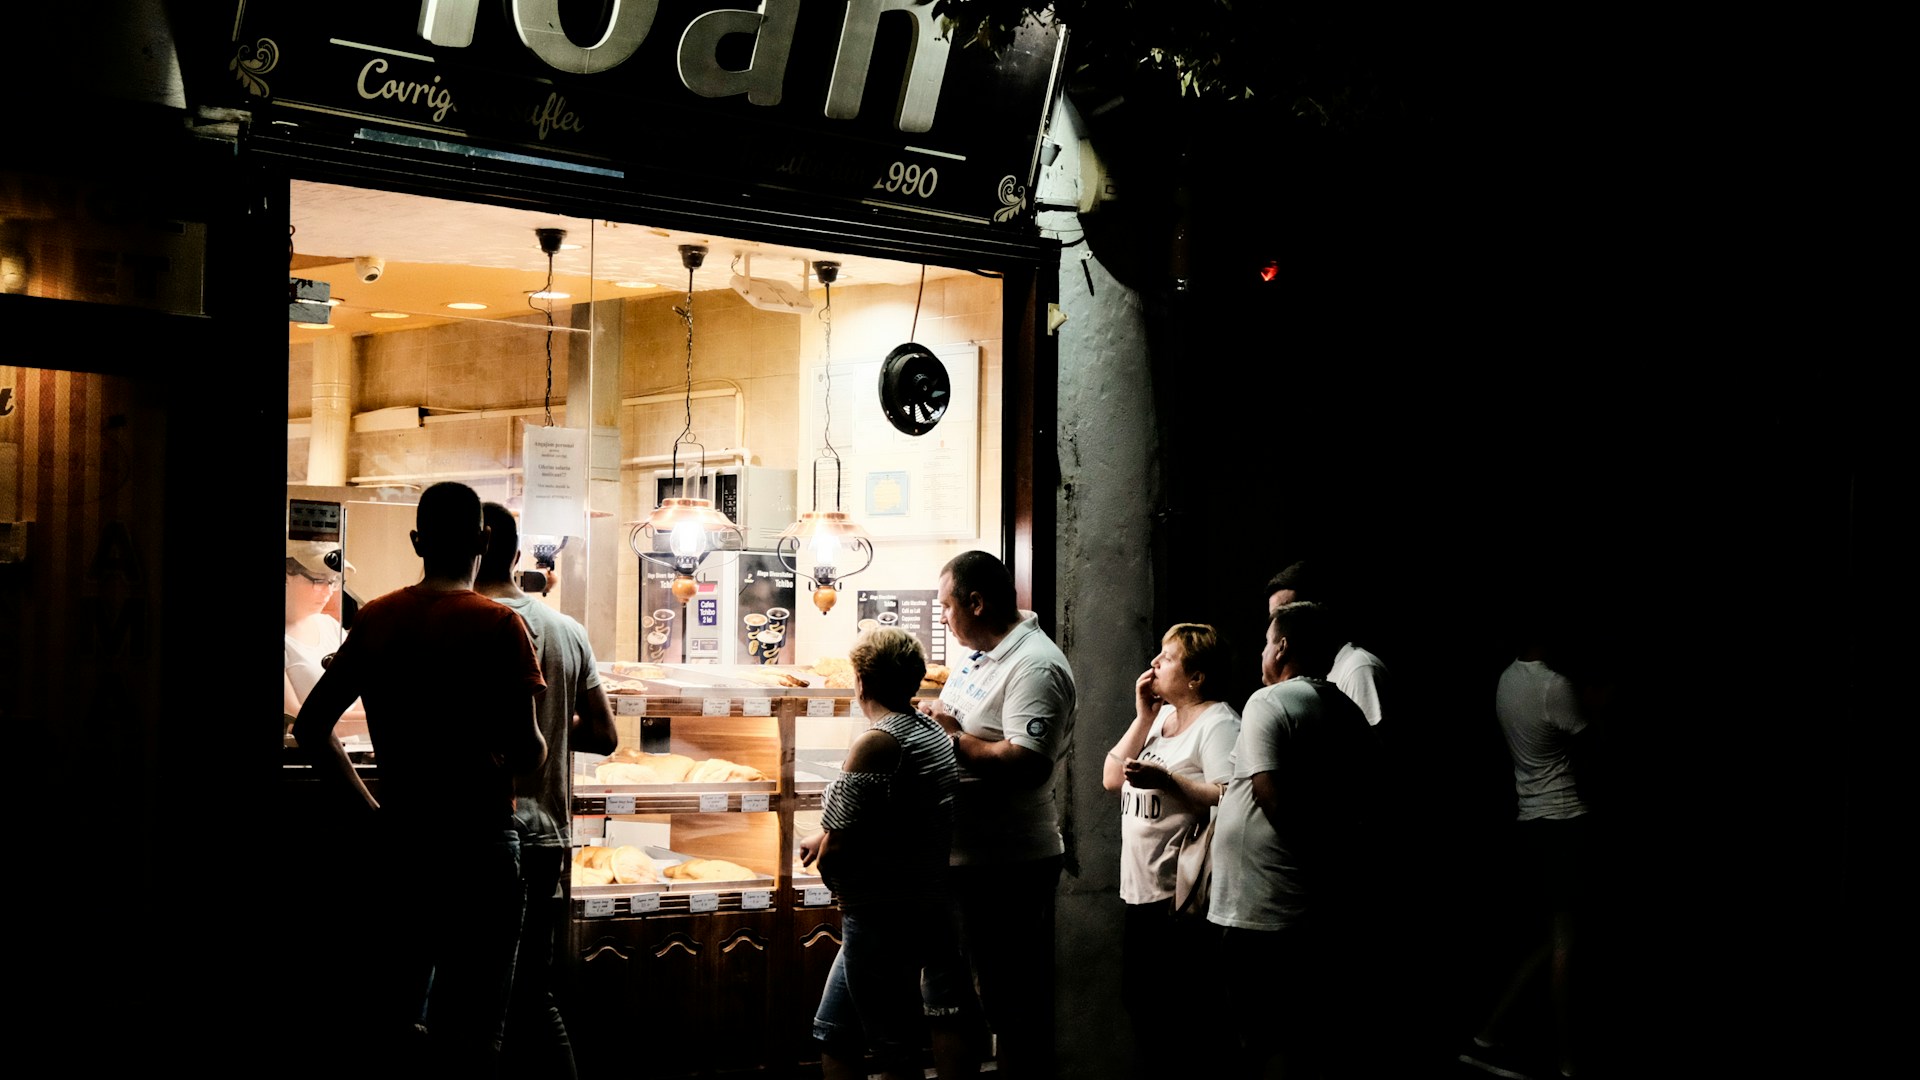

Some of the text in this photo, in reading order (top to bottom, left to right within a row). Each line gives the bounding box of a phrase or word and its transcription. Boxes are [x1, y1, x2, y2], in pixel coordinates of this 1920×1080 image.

[357, 58, 458, 122] Covrig
[417, 0, 952, 133] oan
[775, 579, 794, 588] Tchibo
